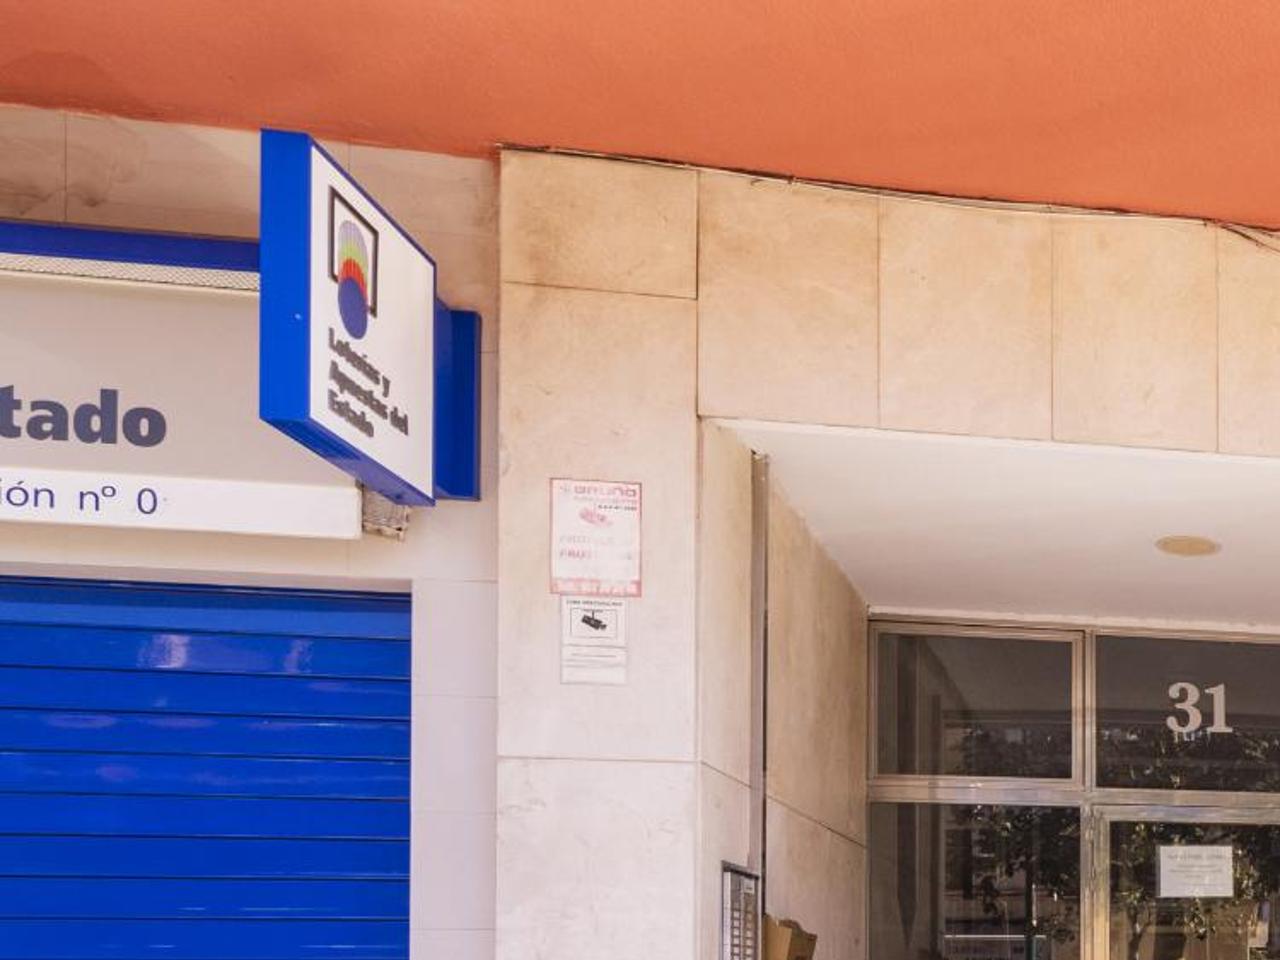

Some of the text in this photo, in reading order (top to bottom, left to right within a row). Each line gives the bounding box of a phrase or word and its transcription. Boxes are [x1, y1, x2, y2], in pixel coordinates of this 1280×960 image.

[0, 478, 157, 514] ón nº 0
[1166, 682, 1233, 734] 31
